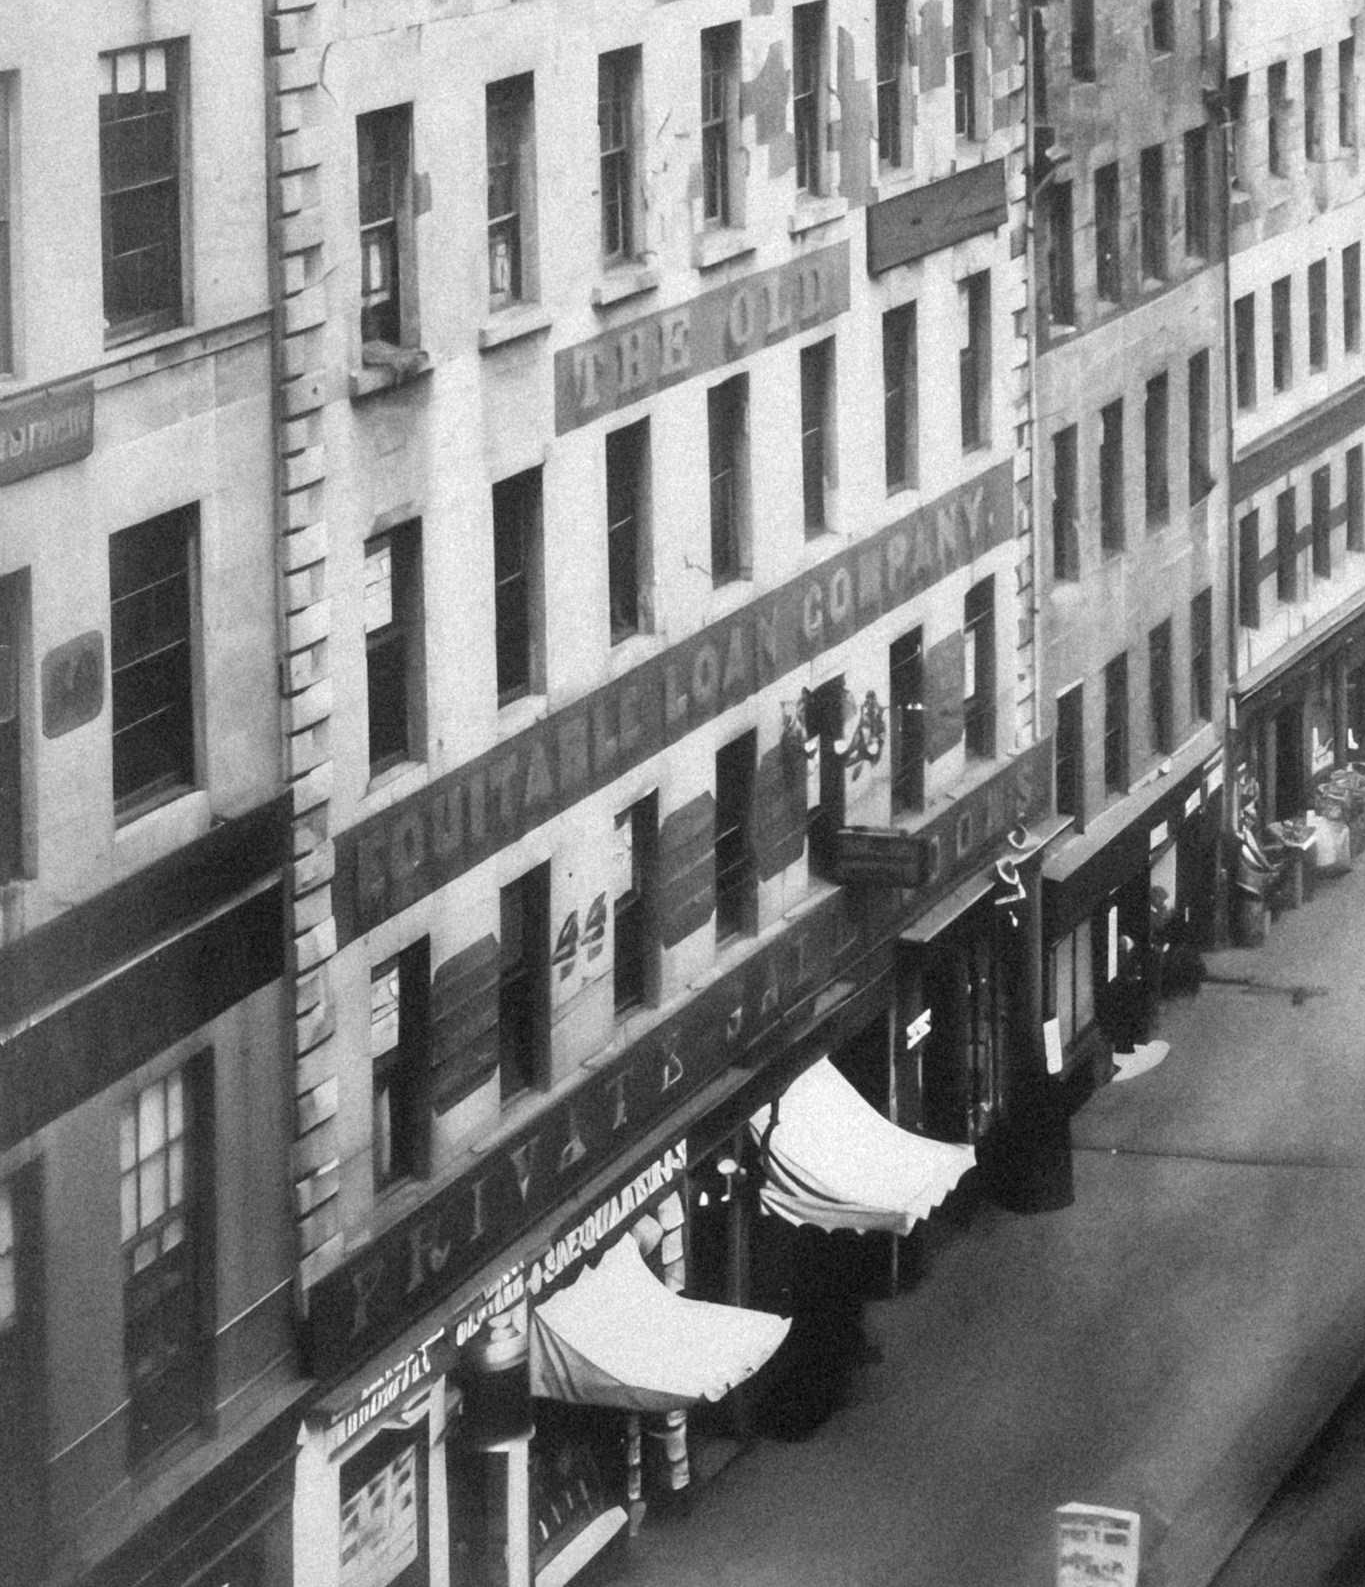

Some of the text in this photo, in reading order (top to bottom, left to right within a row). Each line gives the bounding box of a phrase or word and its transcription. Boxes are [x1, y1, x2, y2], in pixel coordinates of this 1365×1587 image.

[571, 264, 829, 408] THE OLD
[356, 685, 644, 906] EQUITABLE
[665, 604, 784, 721] LOAN
[350, 1034, 687, 1338] PRIVATE
